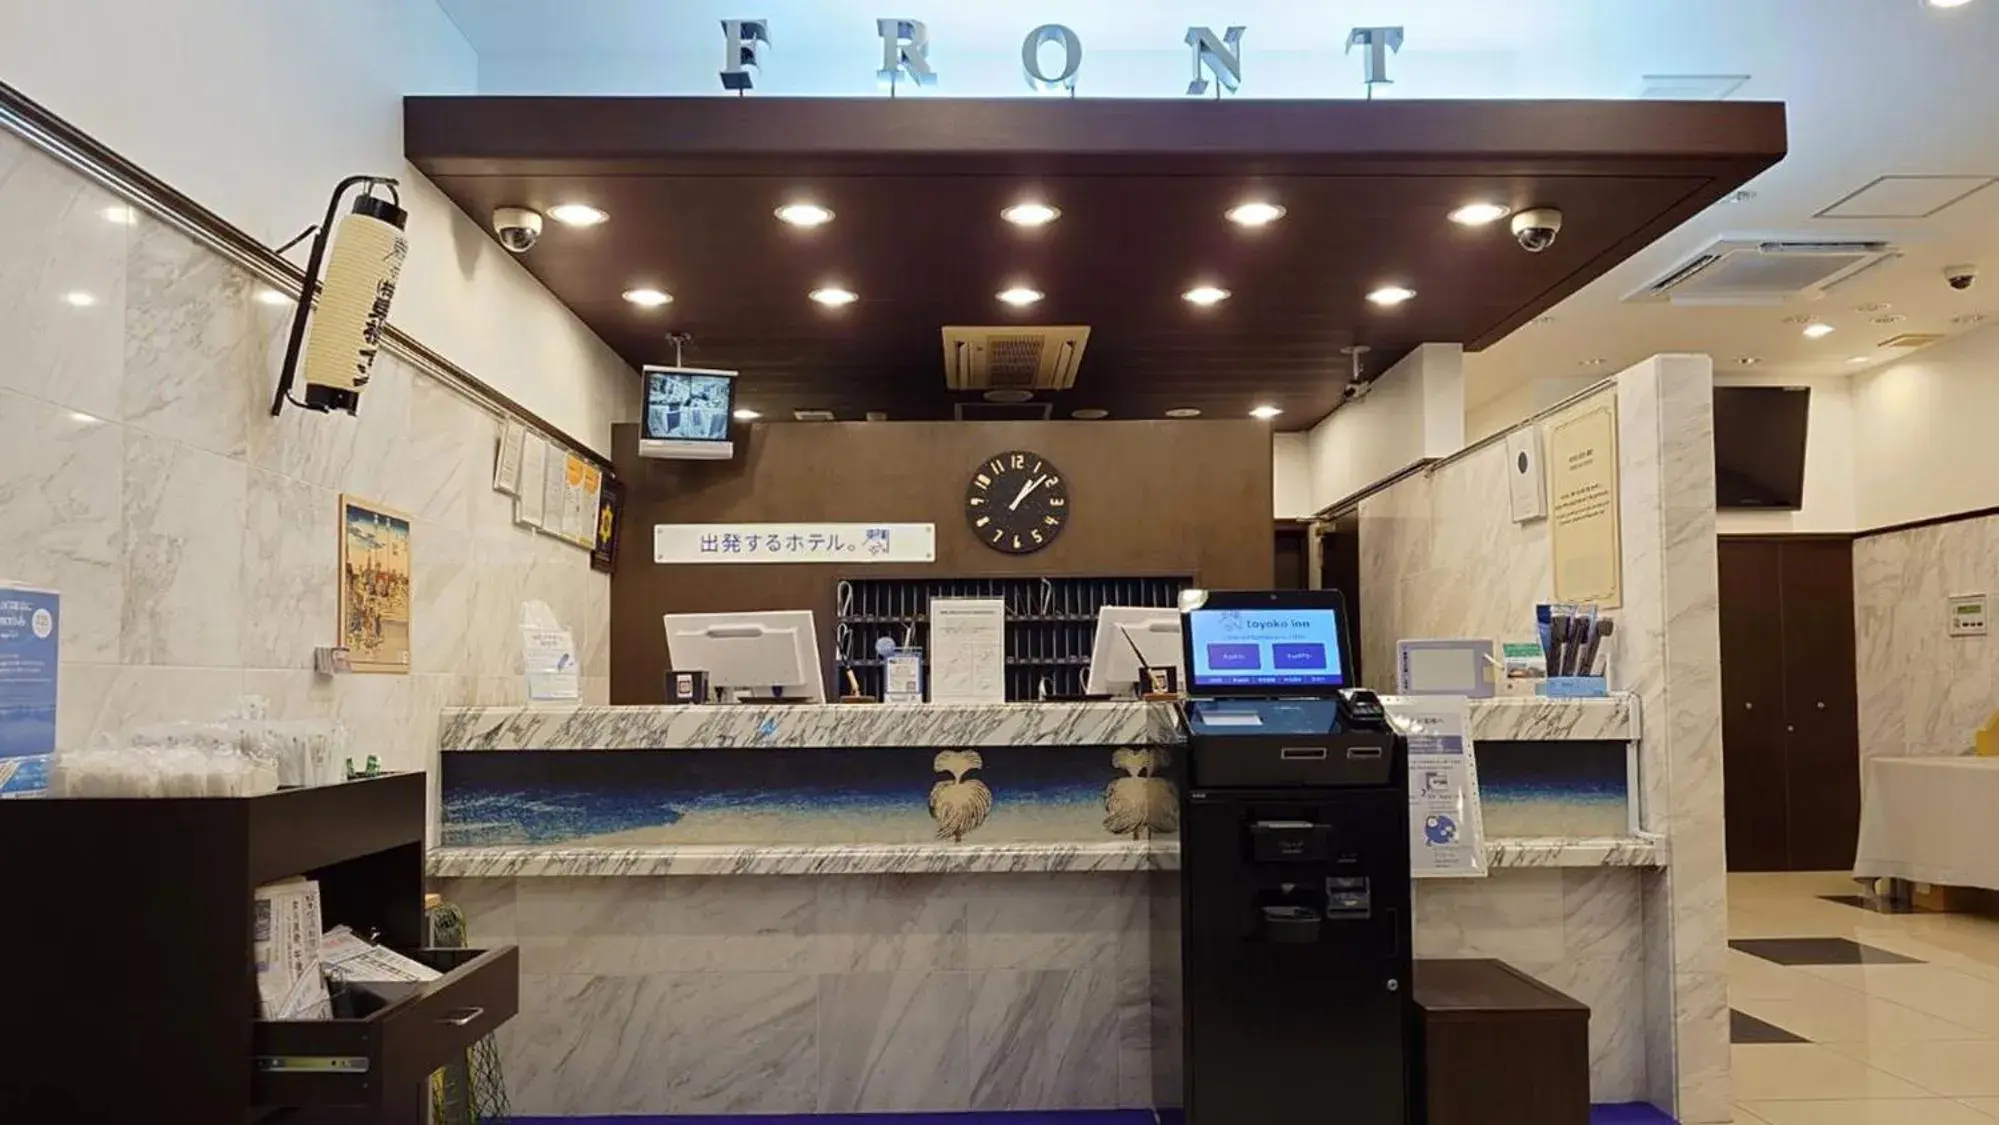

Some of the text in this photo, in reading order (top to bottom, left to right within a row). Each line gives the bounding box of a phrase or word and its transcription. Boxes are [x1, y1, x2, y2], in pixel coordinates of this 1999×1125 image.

[719, 18, 1405, 94] FRONT
[990, 459, 1005, 475] 11
[1011, 454, 1024, 469] 12
[1033, 461, 1042, 474] 1
[974, 474, 991, 490] 10
[1044, 476, 1059, 488] 2
[970, 497, 985, 506] 9
[1049, 497, 1064, 507] 3
[976, 516, 990, 528] 8
[1044, 515, 1059, 525] 4
[992, 529, 1004, 542] 7
[1013, 534, 1021, 548] 6
[1031, 529, 1043, 543] 5
[700, 533, 856, 553] 出発するホテル。
[1246, 619, 1311, 630] toyoko inn
